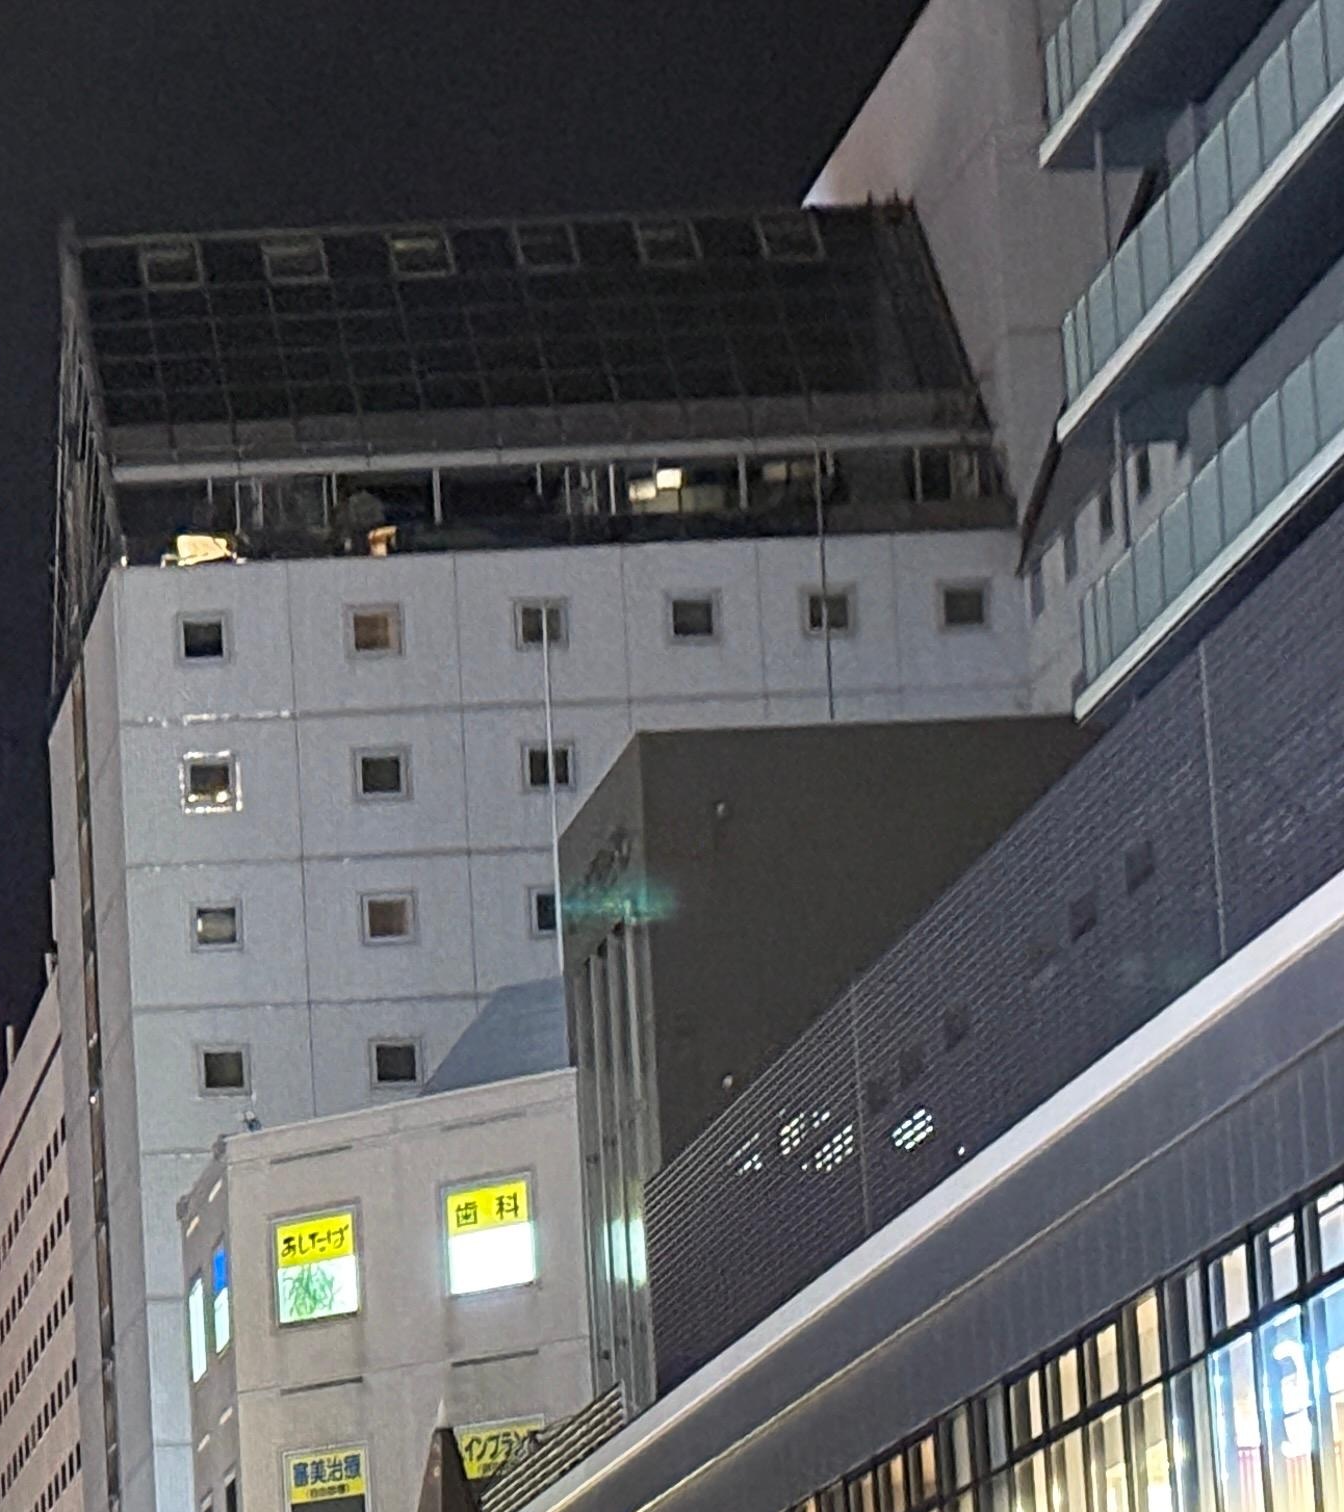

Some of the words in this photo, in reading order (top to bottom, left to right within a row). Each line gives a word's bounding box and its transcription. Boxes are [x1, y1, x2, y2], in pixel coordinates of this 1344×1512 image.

[456, 1192, 519, 1228] 歯科
[280, 1223, 350, 1259] あしたば
